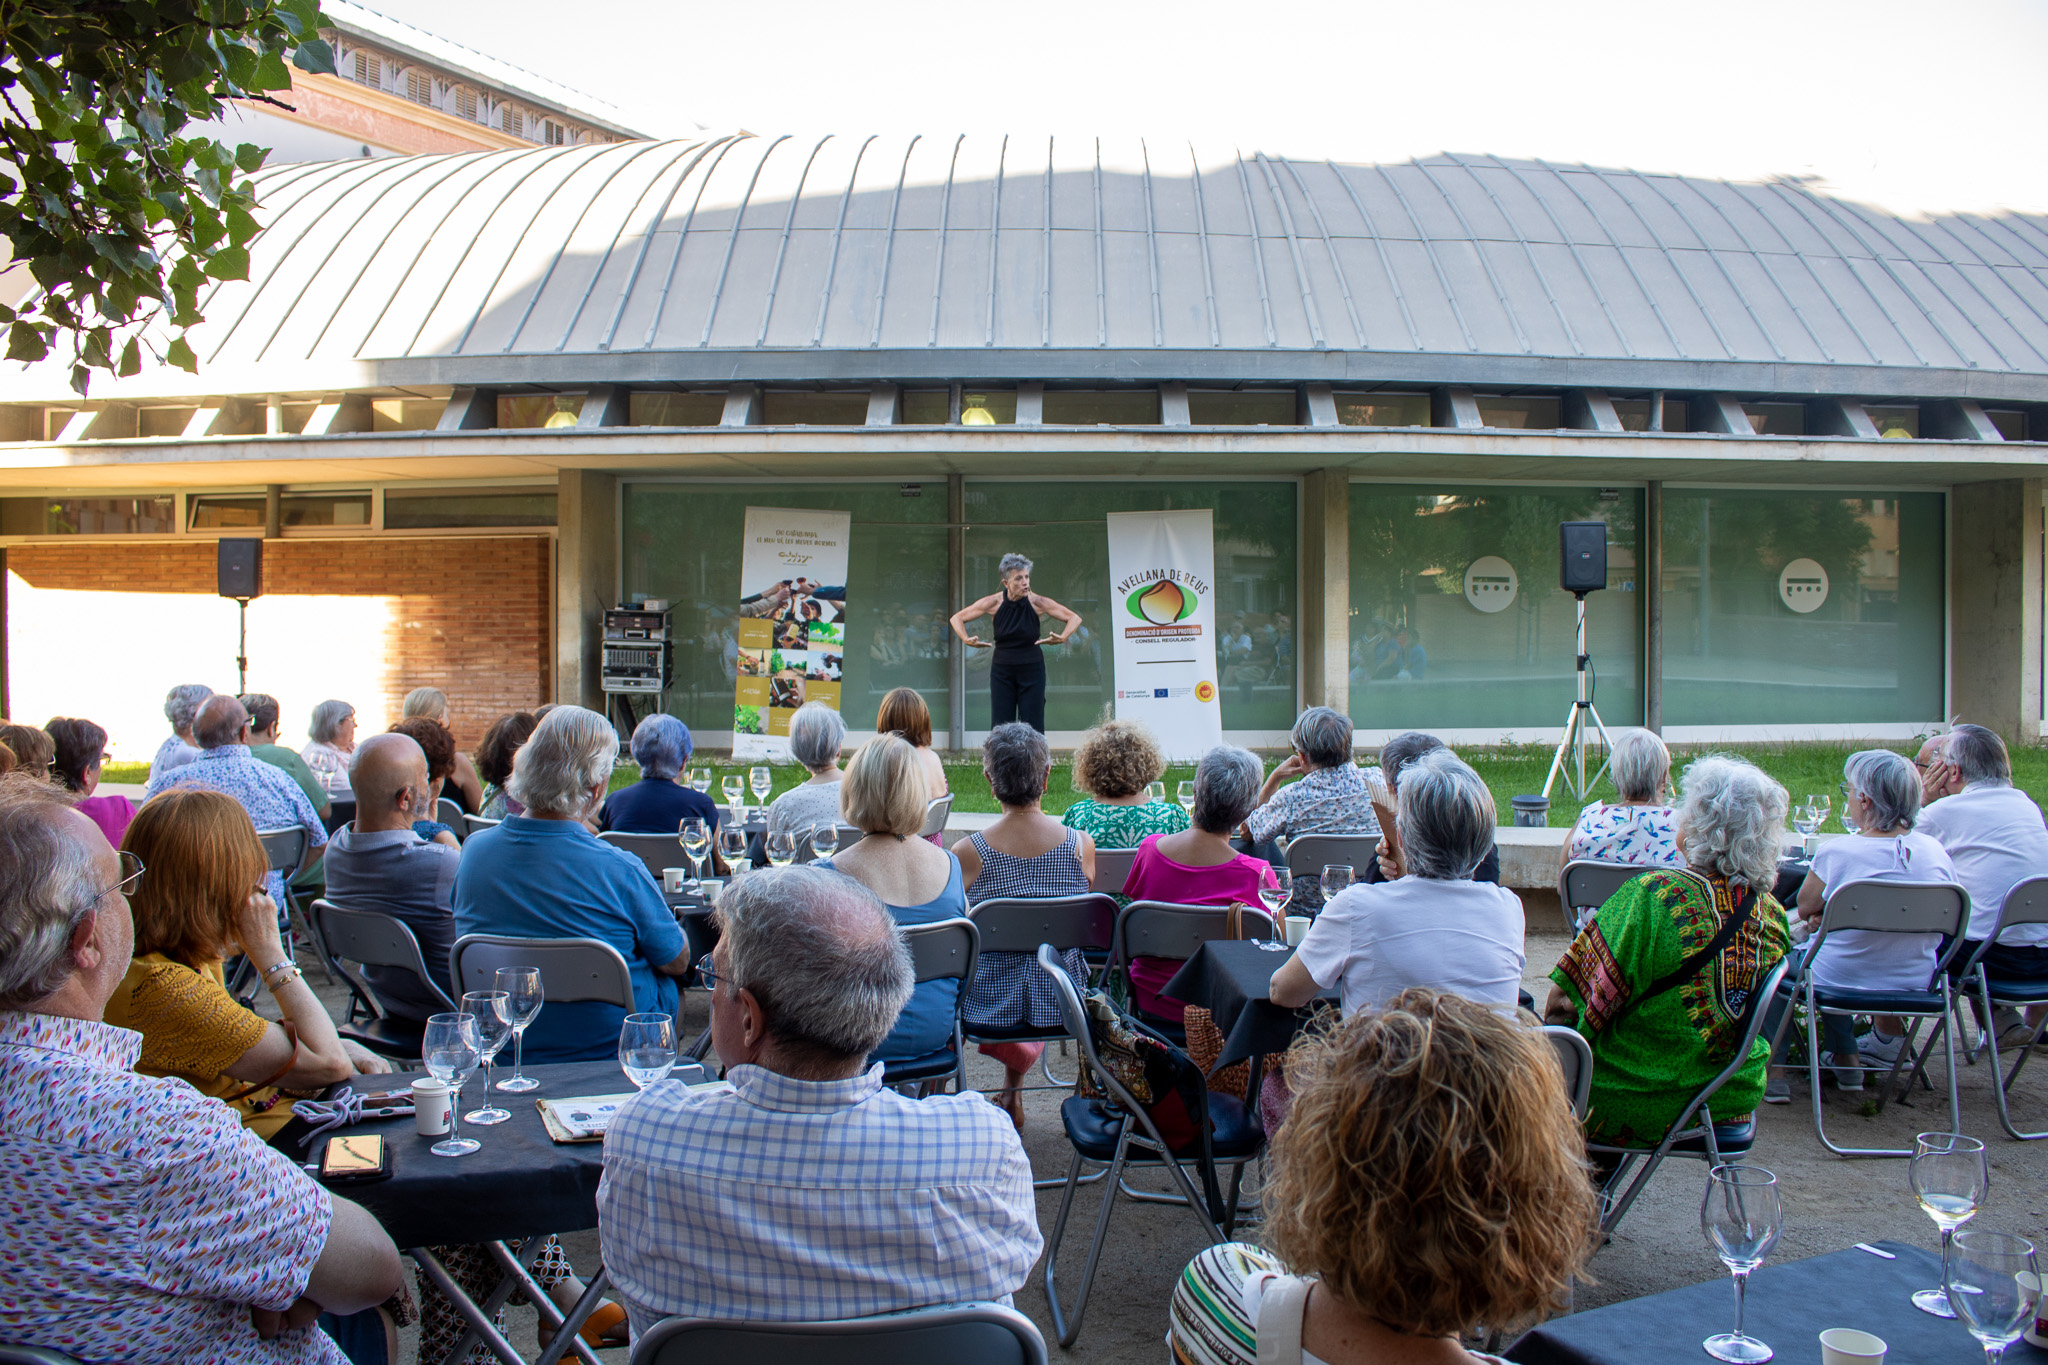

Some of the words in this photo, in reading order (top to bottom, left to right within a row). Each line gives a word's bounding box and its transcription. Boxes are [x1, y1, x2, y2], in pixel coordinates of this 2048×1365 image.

[1117, 568, 1166, 595] AVELLANA
[1169, 569, 1182, 581] DE
[1183, 572, 1209, 595] REUS
[1126, 628, 1155, 637] DENOMINACIÓ
[1178, 627, 1201, 636] PROTEGIDA
